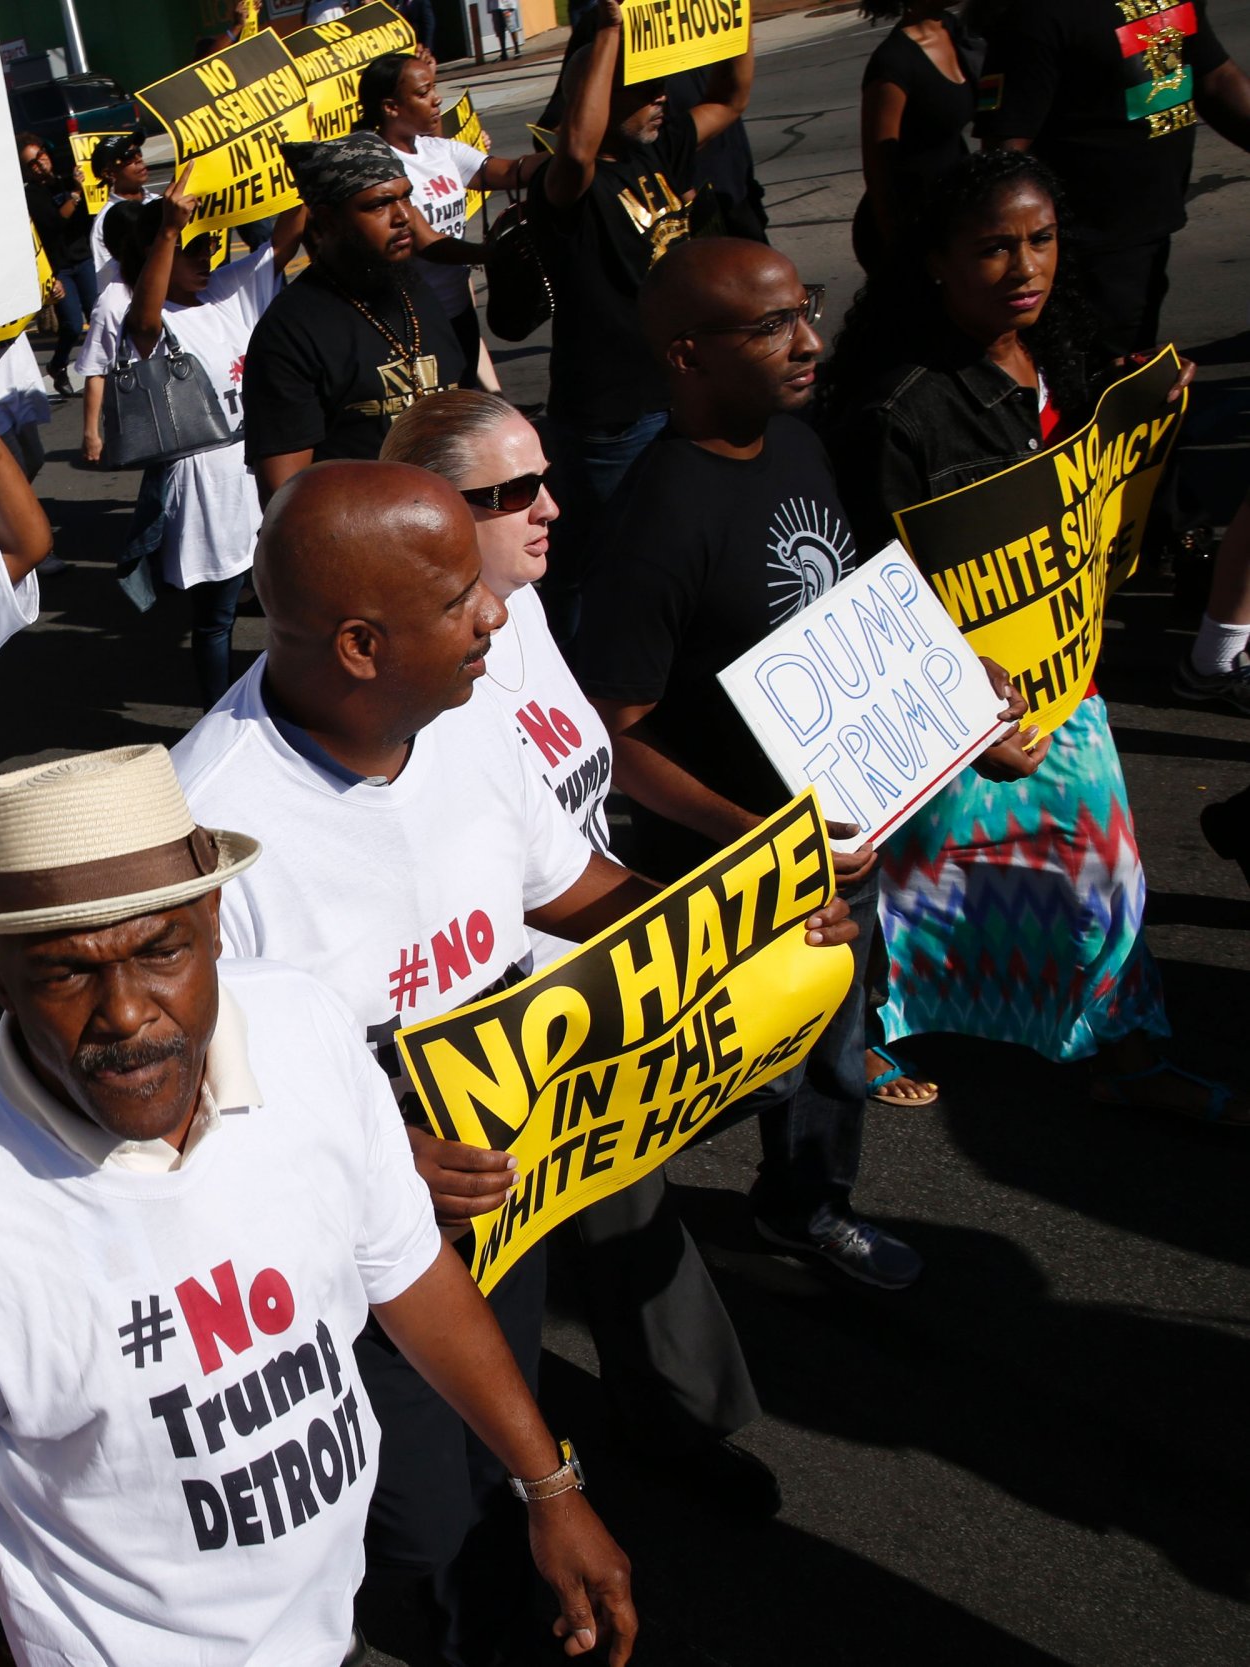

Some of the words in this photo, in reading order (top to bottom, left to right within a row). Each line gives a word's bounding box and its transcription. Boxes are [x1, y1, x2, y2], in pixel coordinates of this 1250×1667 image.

[195, 59, 237, 97] NO
[314, 22, 352, 43] NO
[333, 19, 411, 68] SUPREMACY
[174, 64, 305, 158] ANTI-SEMITISM
[228, 140, 250, 178] IN
[1054, 423, 1099, 507] NO
[931, 525, 1060, 628] WHITE
[1049, 576, 1085, 641] IN
[754, 562, 933, 747] DUMP
[803, 647, 970, 832] TRUMP
[421, 984, 591, 1153] NO
[609, 808, 825, 1048] HATE
[550, 1063, 620, 1142] IN
[638, 986, 743, 1105] THE
[634, 1010, 826, 1160] HOUSE
[149, 1318, 343, 1459] Trump
[181, 1381, 367, 1552] DETROIT
